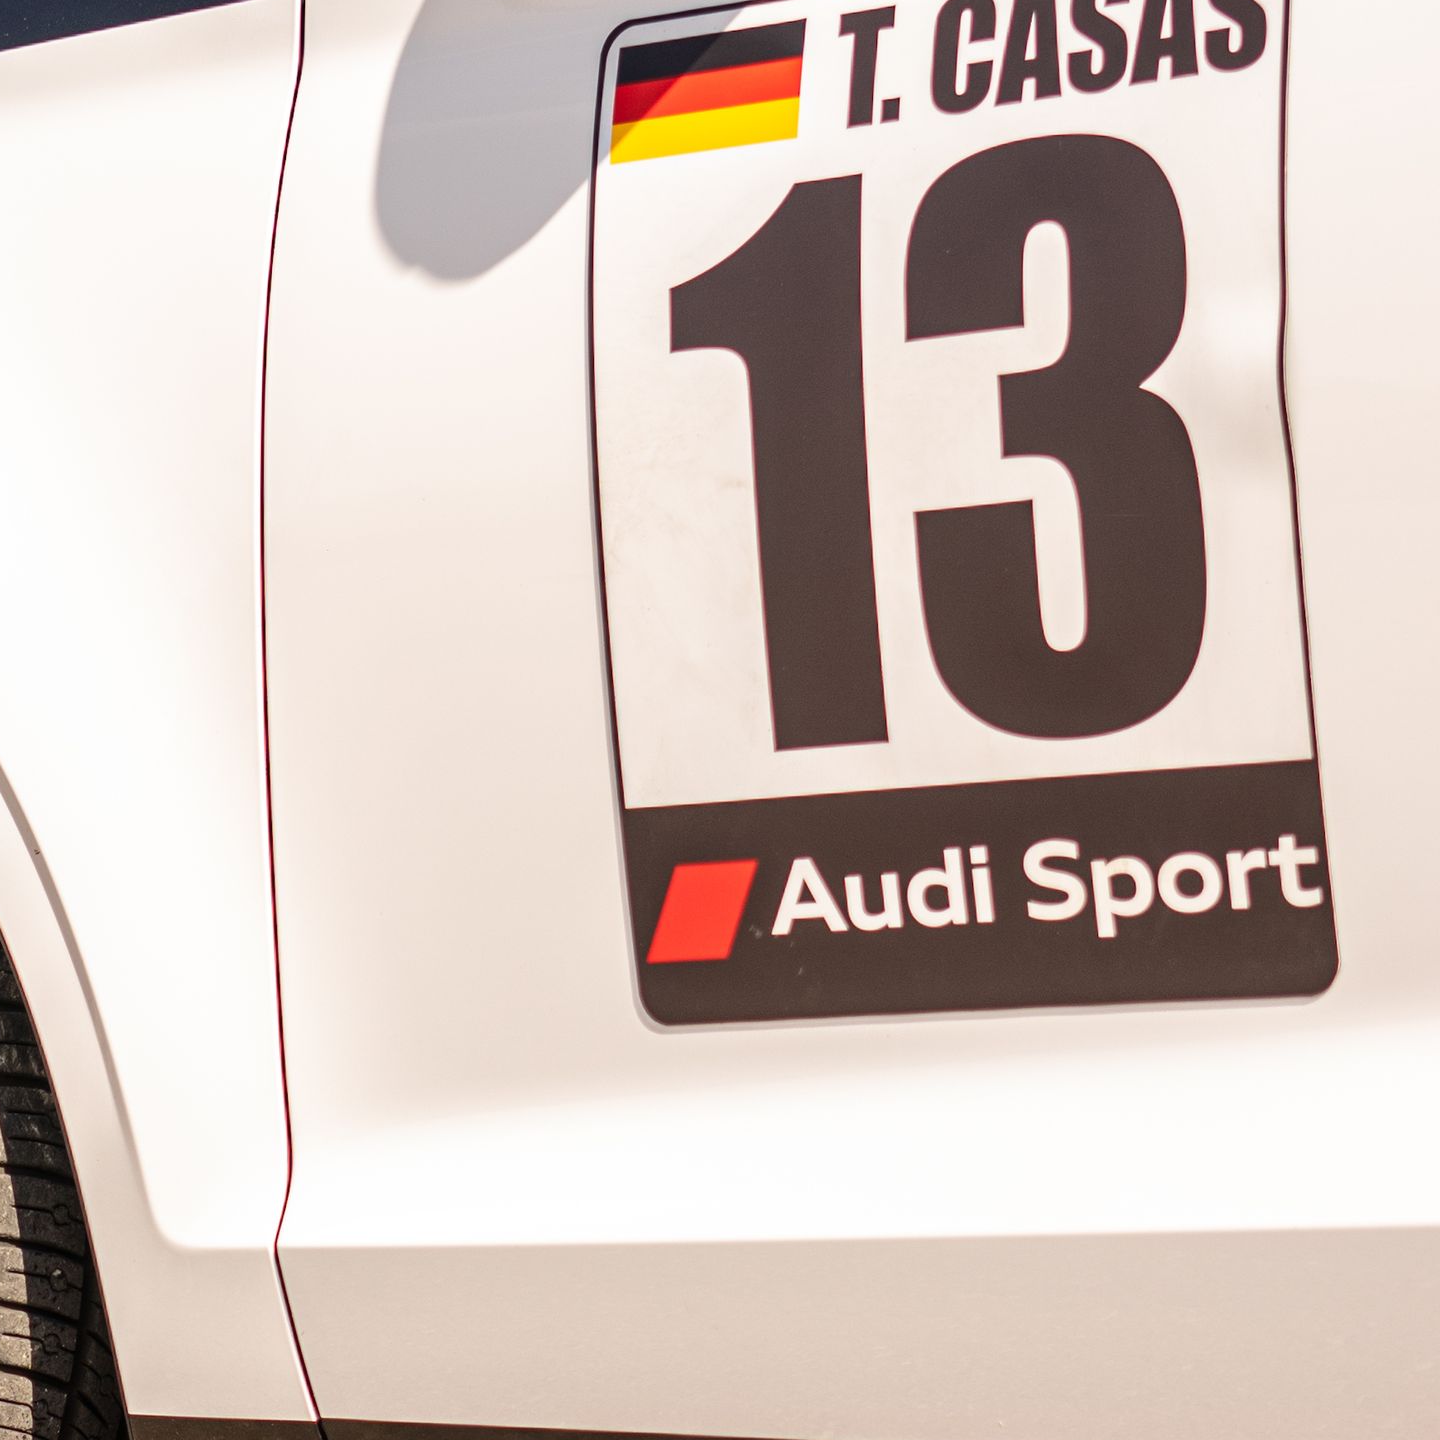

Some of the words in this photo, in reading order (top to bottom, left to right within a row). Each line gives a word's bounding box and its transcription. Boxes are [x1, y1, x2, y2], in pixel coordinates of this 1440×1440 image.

[839, 6, 900, 129] T.
[669, 133, 1207, 751] 13
[772, 847, 993, 935] Audi
[1025, 835, 1322, 938] Sport
